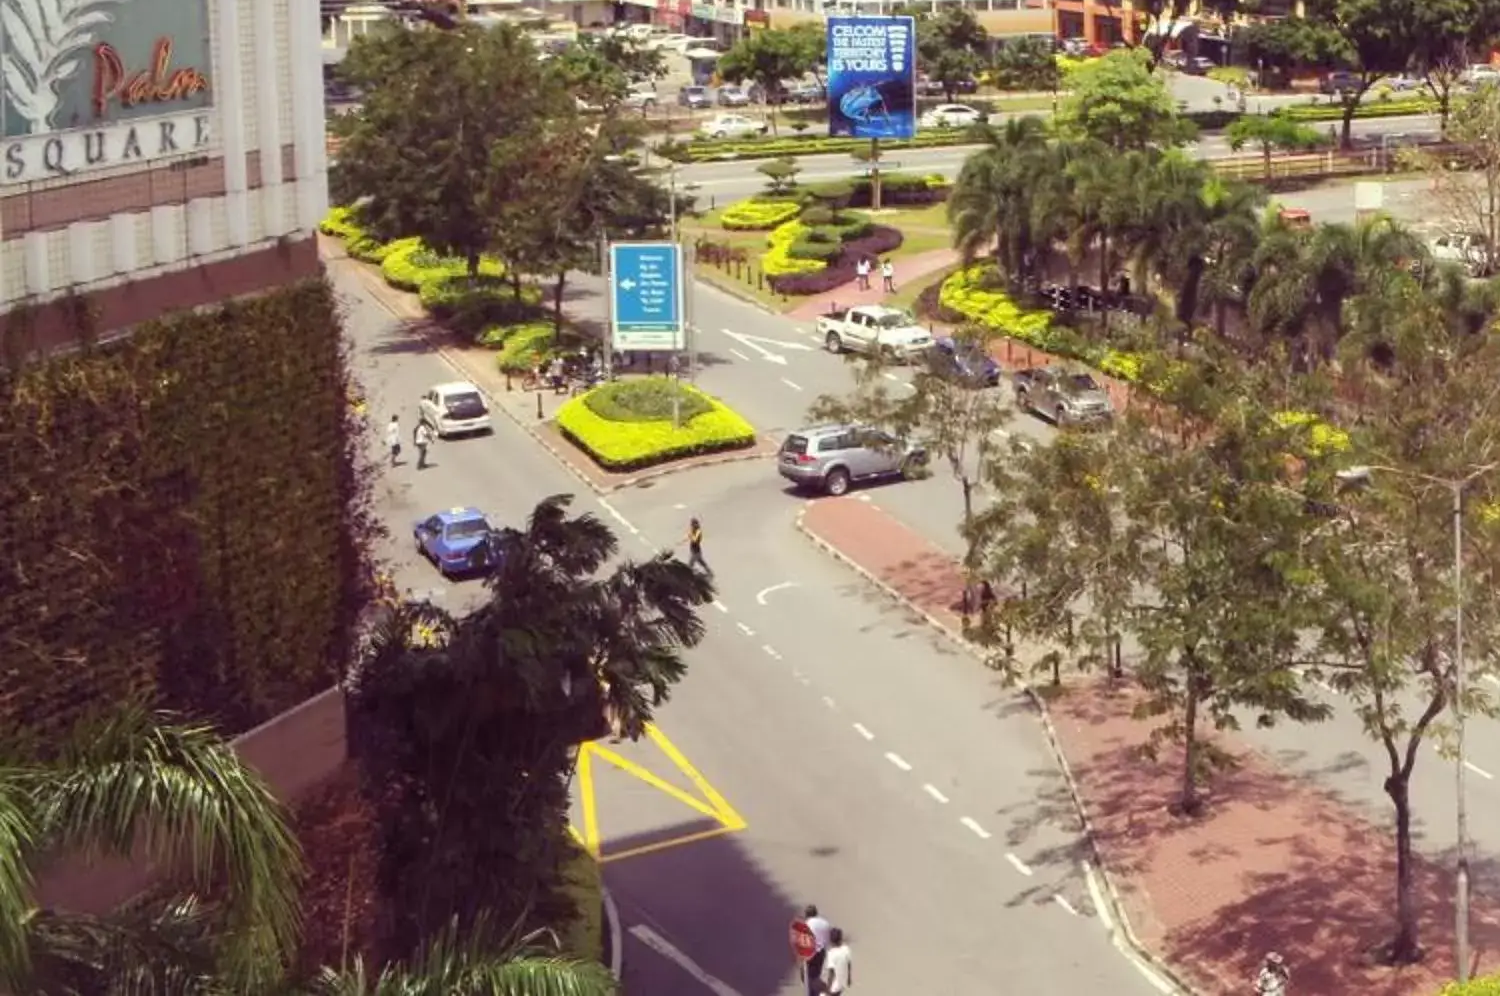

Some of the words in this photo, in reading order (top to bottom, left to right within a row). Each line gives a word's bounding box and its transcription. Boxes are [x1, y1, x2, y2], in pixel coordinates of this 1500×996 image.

[832, 26, 887, 37] CELCOM
[92, 35, 207, 118] Palm
[846, 59, 887, 71] YOURS
[6, 116, 209, 178] SQUARE
